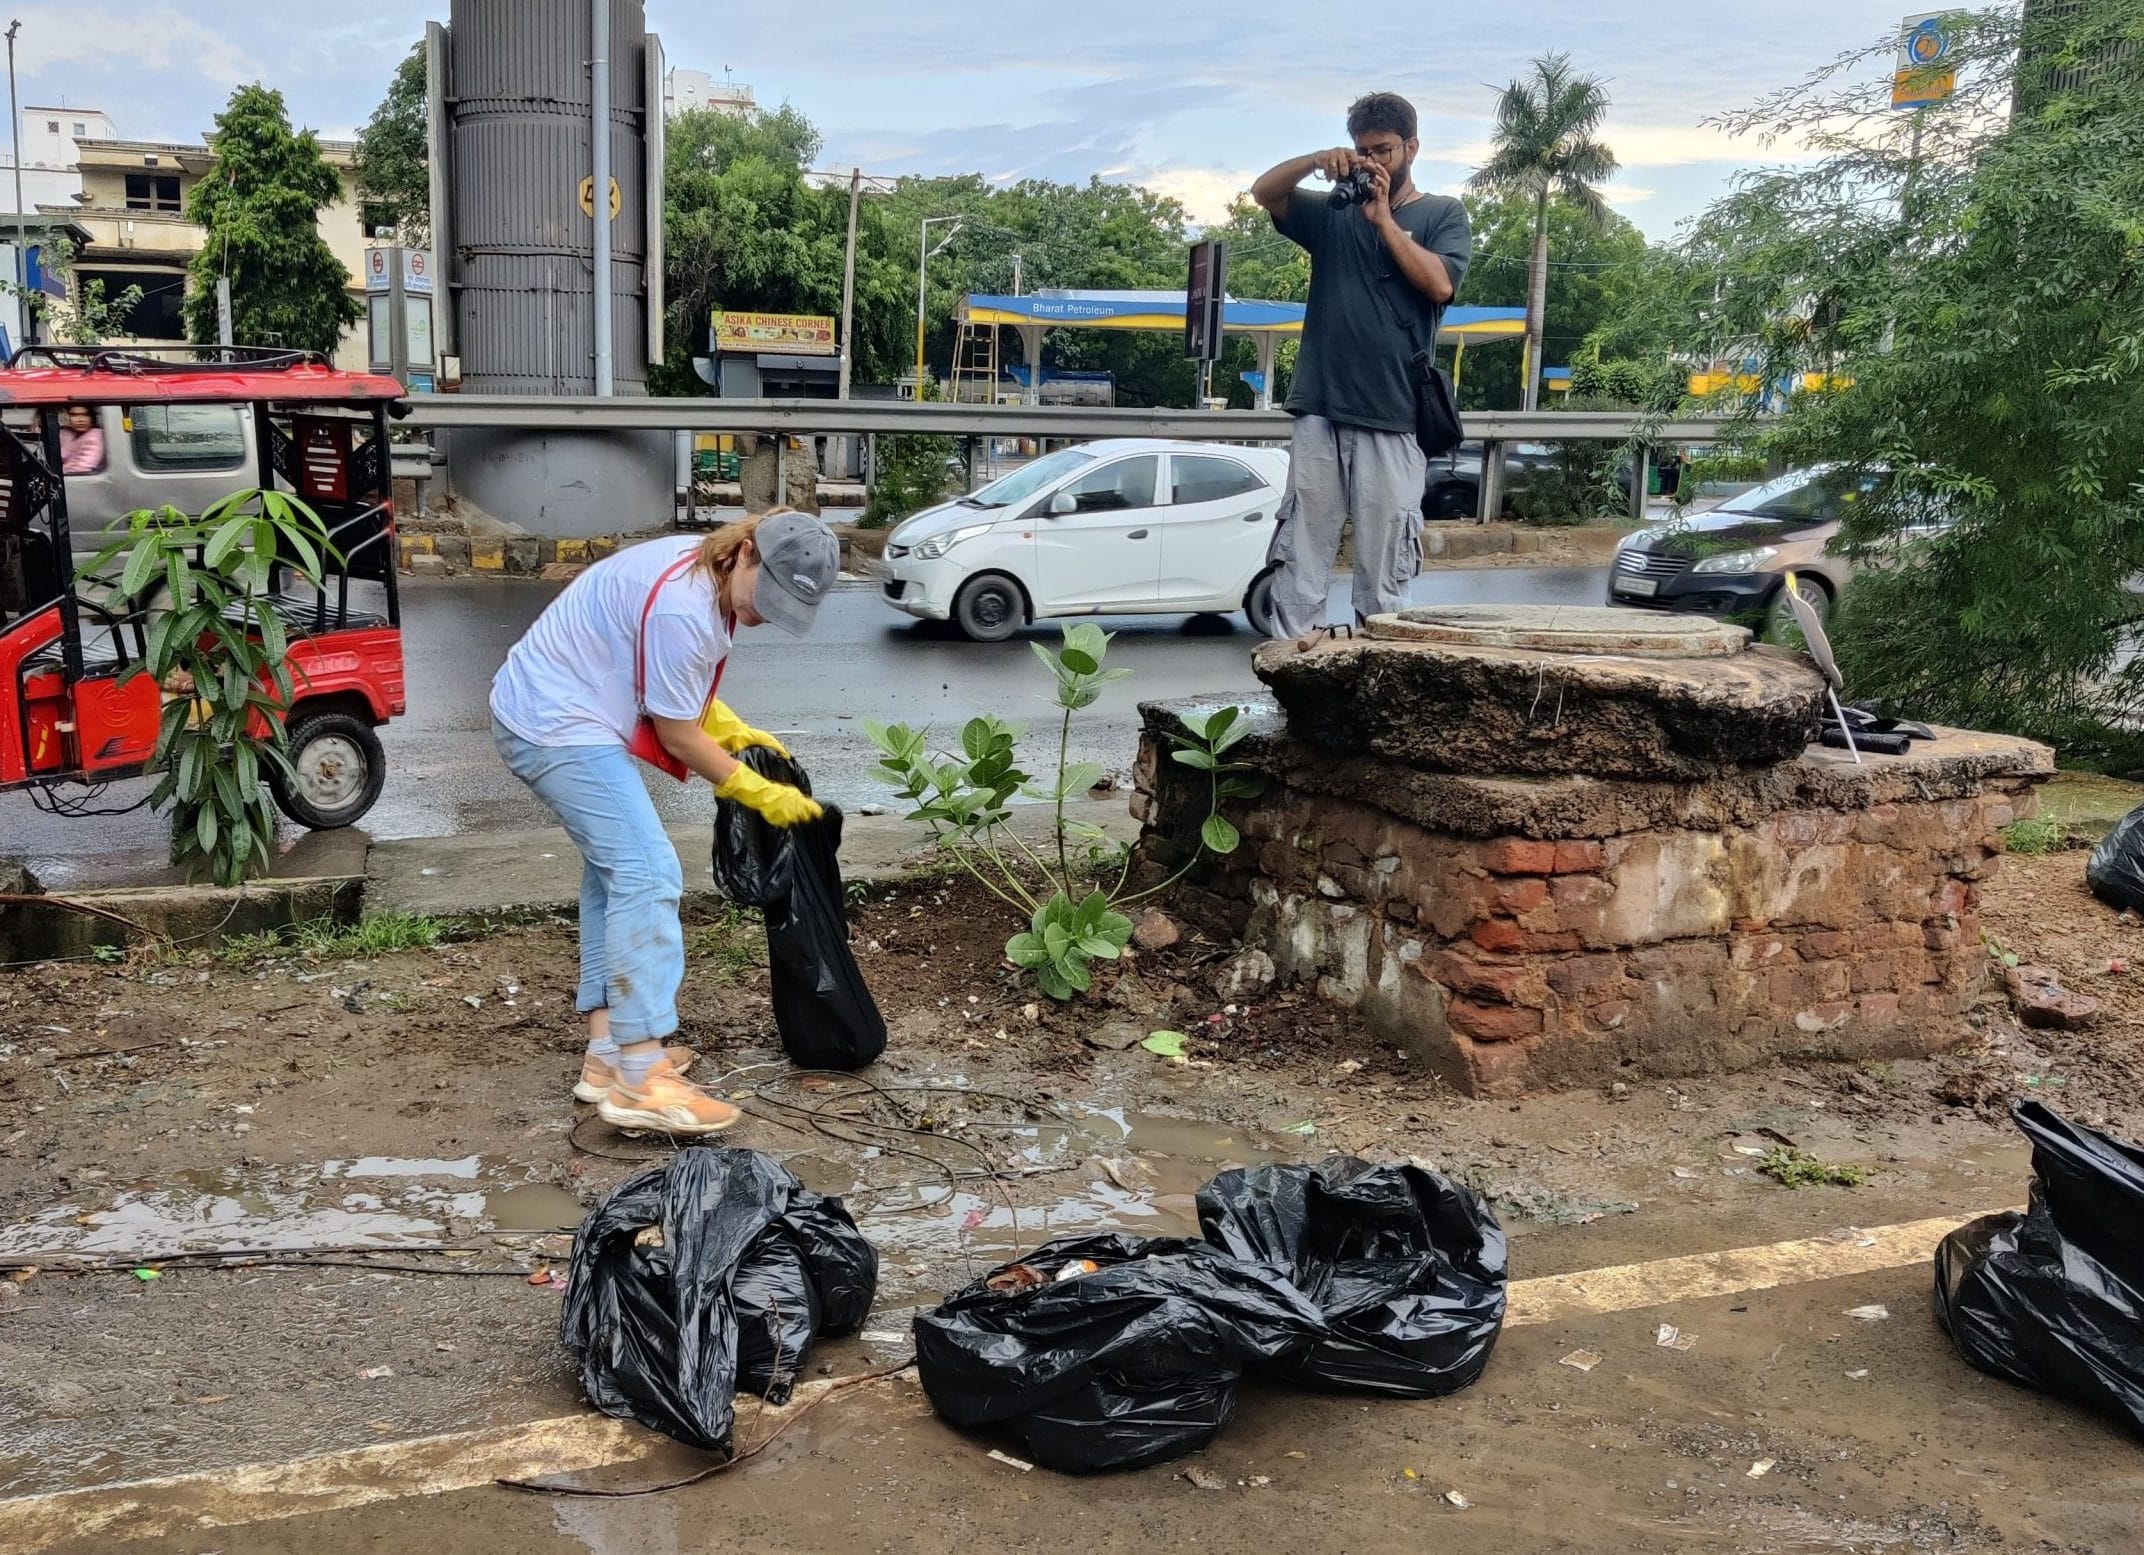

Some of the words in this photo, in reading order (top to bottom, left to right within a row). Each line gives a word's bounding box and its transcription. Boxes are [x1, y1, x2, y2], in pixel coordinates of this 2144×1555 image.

[1033, 303, 1064, 313] Bharat
[1067, 304, 1114, 315] Petroleum
[725, 315, 752, 325] ASIKA
[755, 316, 793, 327] CHINESE
[796, 318, 831, 329] CORNER
